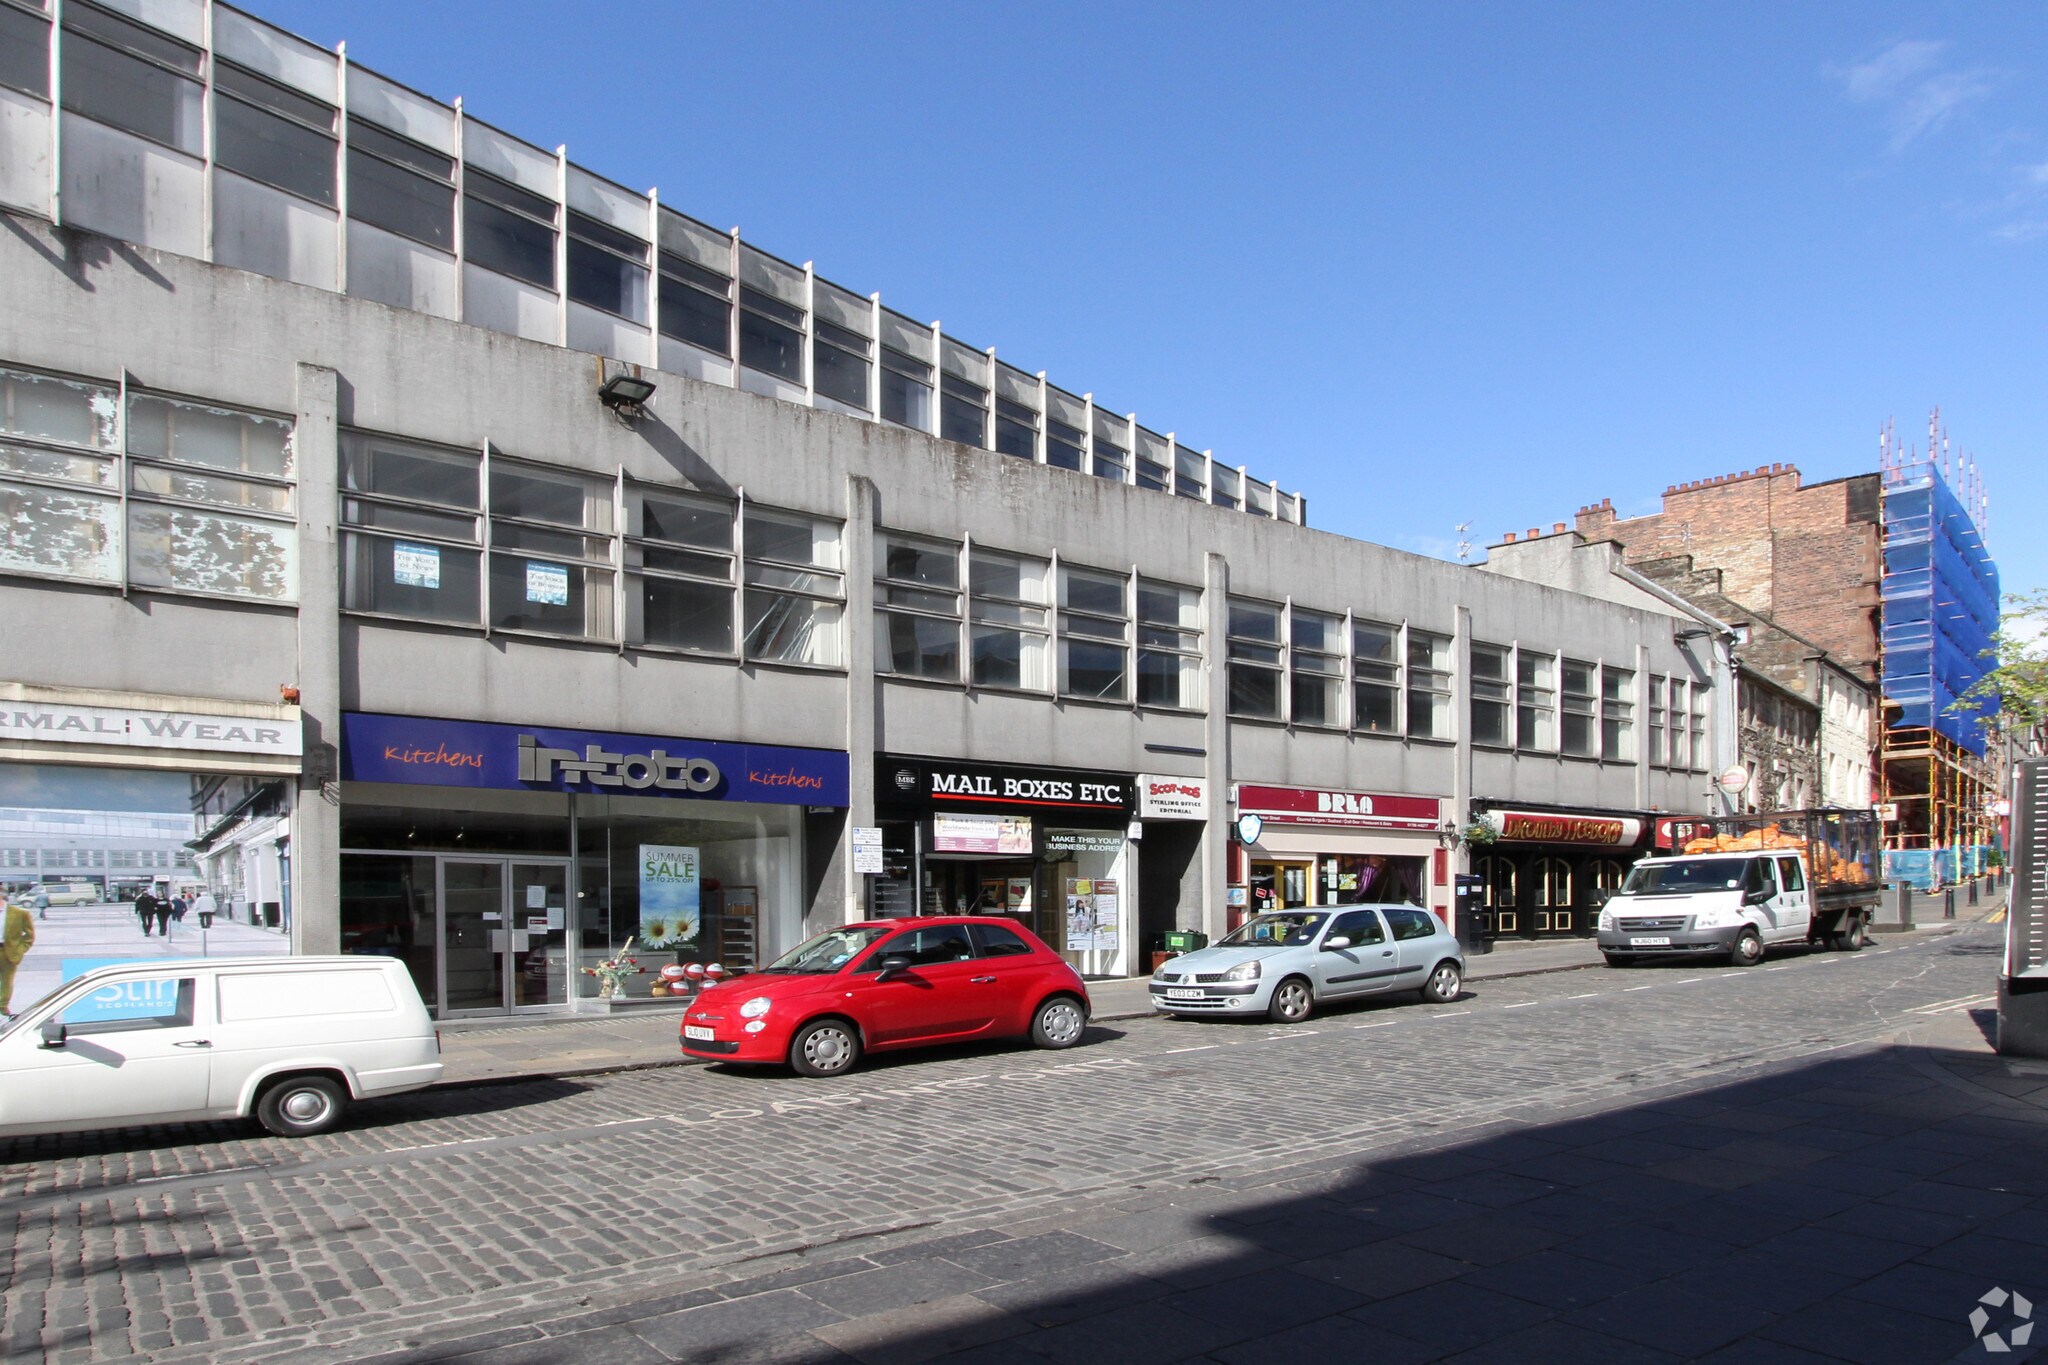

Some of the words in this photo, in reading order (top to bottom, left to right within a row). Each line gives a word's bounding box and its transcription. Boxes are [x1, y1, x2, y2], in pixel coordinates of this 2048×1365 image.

[140, 717, 282, 744] WEAR
[384, 742, 484, 768] Kitchens
[749, 768, 823, 789] Kitchens
[898, 776, 916, 784] MBE
[931, 773, 997, 796] MAIL
[1003, 778, 1073, 800] BOXES
[1080, 783, 1123, 803] ETC.
[1150, 799, 1179, 807] STIRLING
[1181, 800, 1202, 808] OFFICE
[1317, 792, 1373, 815] BREA
[1159, 807, 1192, 815] EDITORIAL
[1051, 835, 1076, 843] MAKE
[1077, 836, 1096, 844] THIS
[1097, 837, 1120, 845] YOUR
[1046, 843, 1086, 851] BUSINESS
[646, 851, 694, 863] SUMMER
[645, 861, 695, 878] SALE
[97, 1001, 174, 1009] SCOTLAND'S
